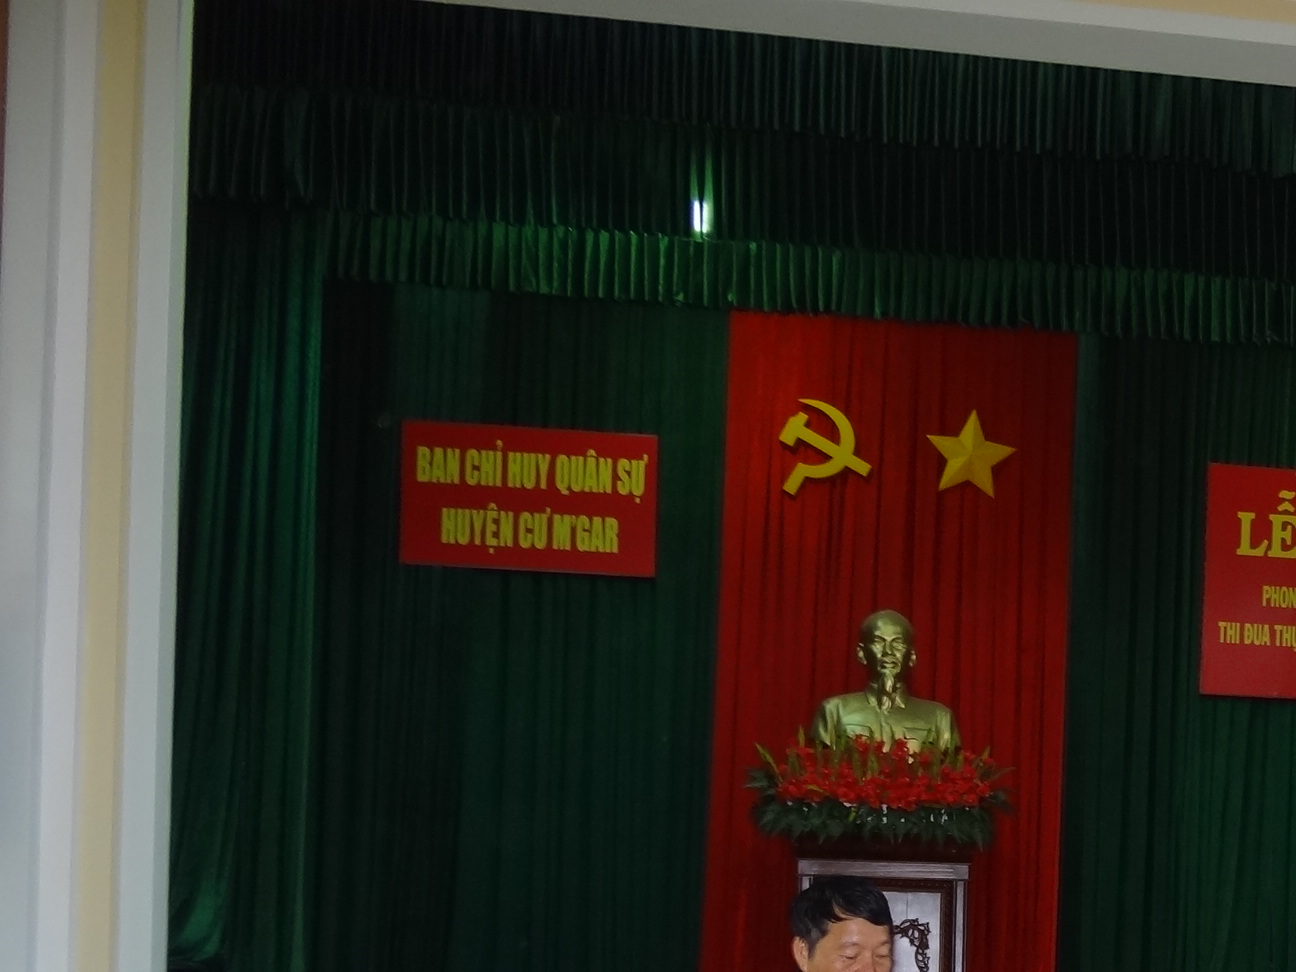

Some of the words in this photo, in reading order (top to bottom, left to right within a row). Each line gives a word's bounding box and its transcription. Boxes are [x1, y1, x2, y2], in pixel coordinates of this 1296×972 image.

[416, 446, 460, 484] BAN
[465, 440, 503, 487] CHỈ
[508, 451, 551, 489] HUY
[555, 449, 613, 495] QUÂN
[617, 454, 648, 504] SỰ
[441, 503, 514, 554] HUYỆN
[518, 507, 551, 550] CƯ
[553, 514, 619, 554] M'GAR
[1218, 621, 1240, 644] THI
[1243, 623, 1271, 646] ĐUA
